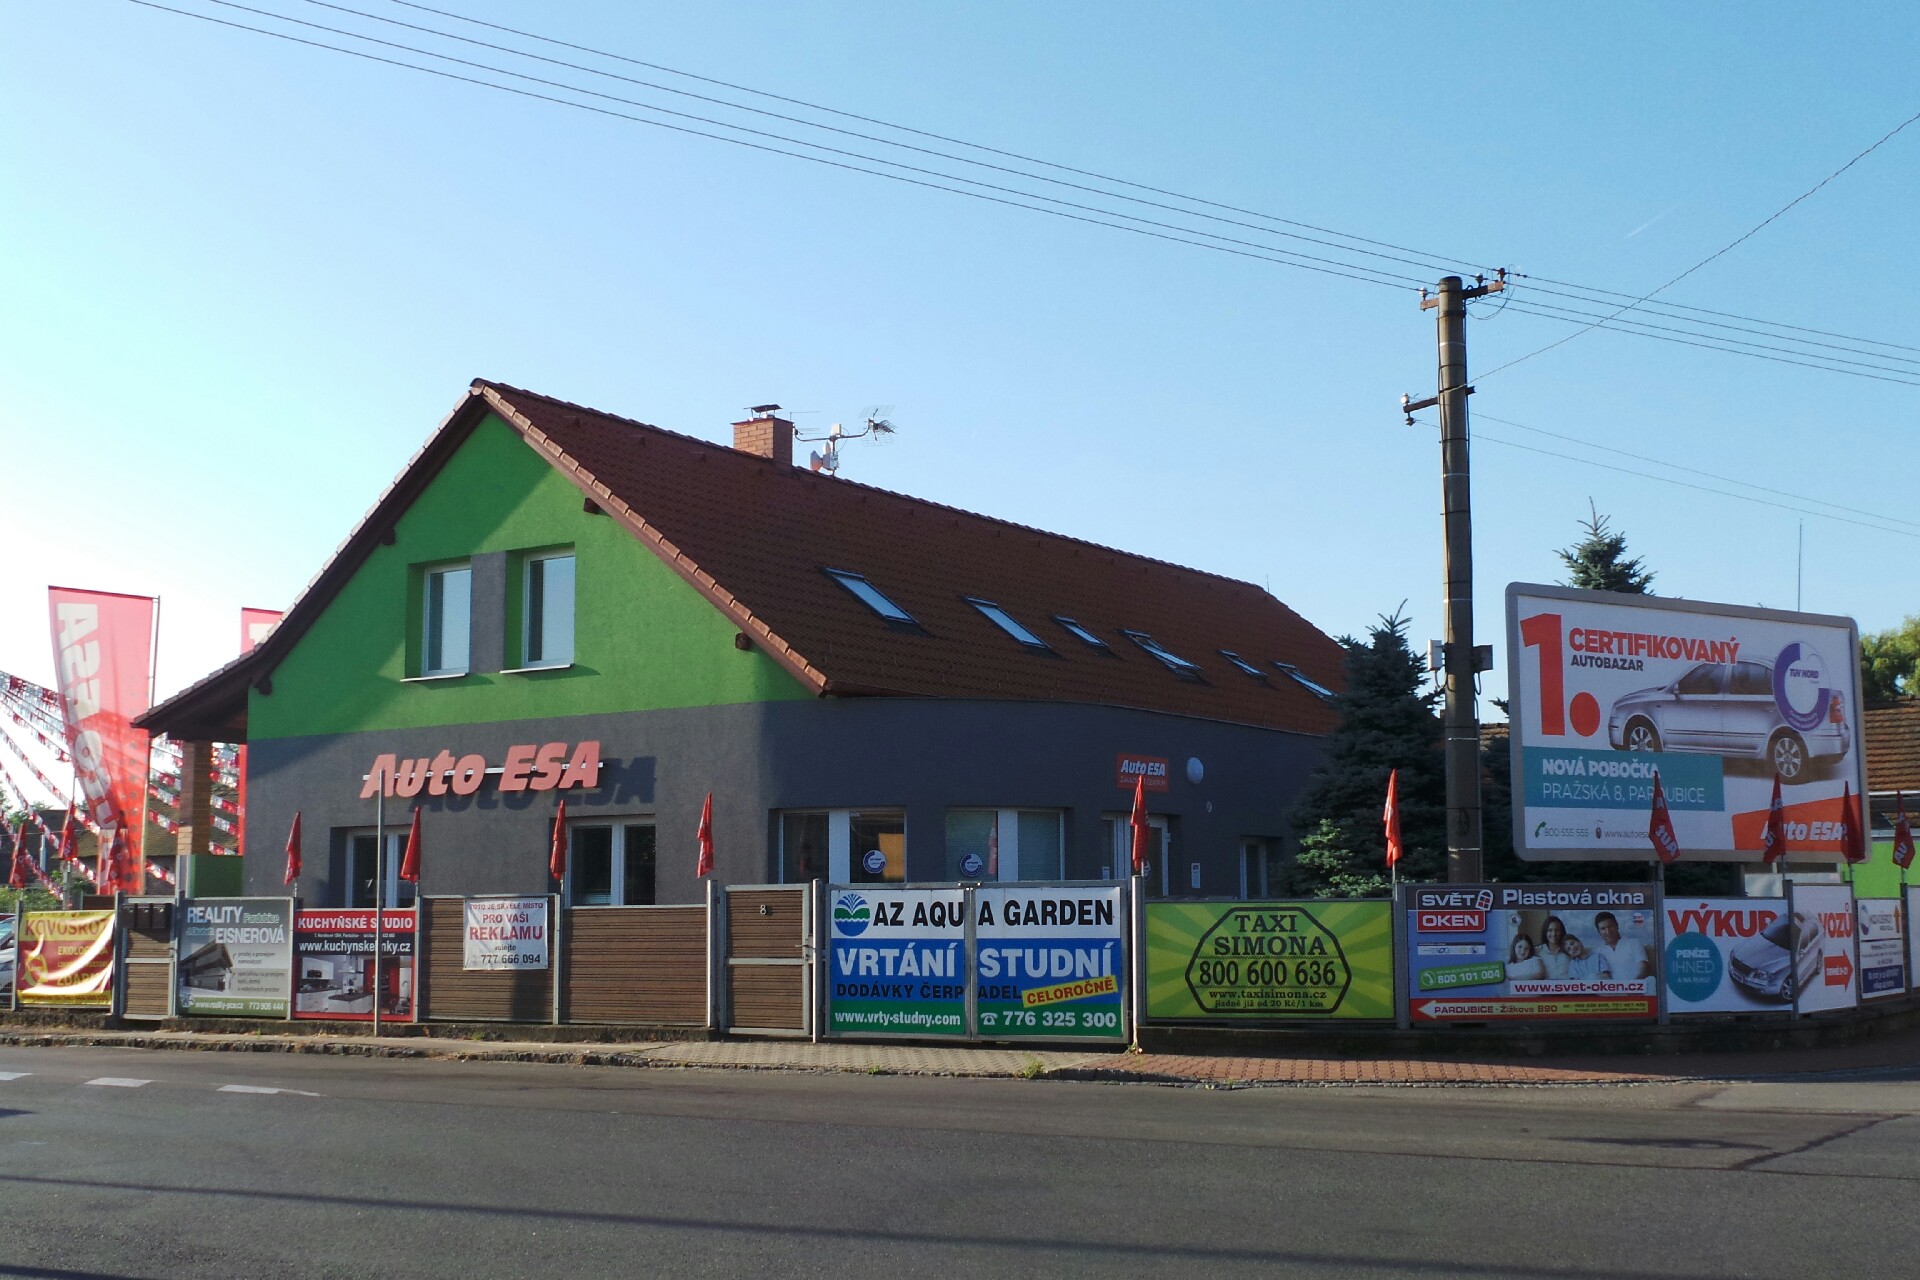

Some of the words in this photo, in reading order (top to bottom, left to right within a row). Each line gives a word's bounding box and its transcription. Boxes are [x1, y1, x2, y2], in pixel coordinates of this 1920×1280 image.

[1569, 627, 1740, 665] CERTIFIKOVANÝ
[1571, 655, 1644, 672] AUTOBAZAR
[1520, 613, 1600, 737] 1.
[359, 748, 487, 799] Auto
[498, 740, 601, 792] ESA
[1120, 759, 1147, 775] Auto
[1147, 762, 1166, 776] ESA
[1542, 757, 1587, 777] NOVÁ
[1588, 758, 1661, 780] POBOČKA
[1543, 780, 1611, 802] PRAŽSKÁ
[1629, 785, 1706, 804] PARUBICE
[1421, 891, 1477, 907] SVĚT
[1502, 889, 1593, 905] Plastová
[1596, 889, 1645, 905] okna
[187, 906, 243, 924] REALITY
[482, 914, 503, 924] PRO
[506, 911, 529, 924] VAŠI
[759, 904, 768, 915] 8
[873, 902, 904, 927] AZ
[1003, 900, 1113, 926] GARDEN
[298, 915, 368, 929] KUCHYŇSKÉ
[370, 917, 413, 929] SUDIO
[1234, 914, 1298, 932] TAXI
[1422, 914, 1480, 927] OKEN
[1667, 902, 1779, 938] VÝKUP
[215, 924, 285, 944] EISNEROVÁ
[469, 926, 543, 941] REKLAMU
[1214, 936, 1328, 956] SIMONA
[481, 954, 498, 964] 777
[501, 954, 519, 964] 666
[522, 953, 541, 964] 094
[836, 942, 957, 977] VRTÁNÍ
[979, 942, 1114, 978] STUDNÍ
[1672, 960, 1715, 974] IHNED
[1200, 960, 1239, 986] 800
[1247, 960, 1287, 986] 600
[1295, 960, 1336, 986] 636
[836, 981, 914, 998] DODÁVKY
[1026, 978, 1114, 1005] CELOROČNĚ
[1209, 989, 1327, 999] www.taxisimona.cz
[1514, 981, 1645, 993] www.svet-oken.cz
[1434, 1005, 1494, 1014] PARDUBICE
[1500, 1003, 1535, 1013] Žižkova
[834, 1011, 961, 1026] www.vrty-studny.com
[1003, 1010, 1036, 1026] 776
[1042, 1012, 1077, 1027] 325
[1082, 1012, 1117, 1028] 300
